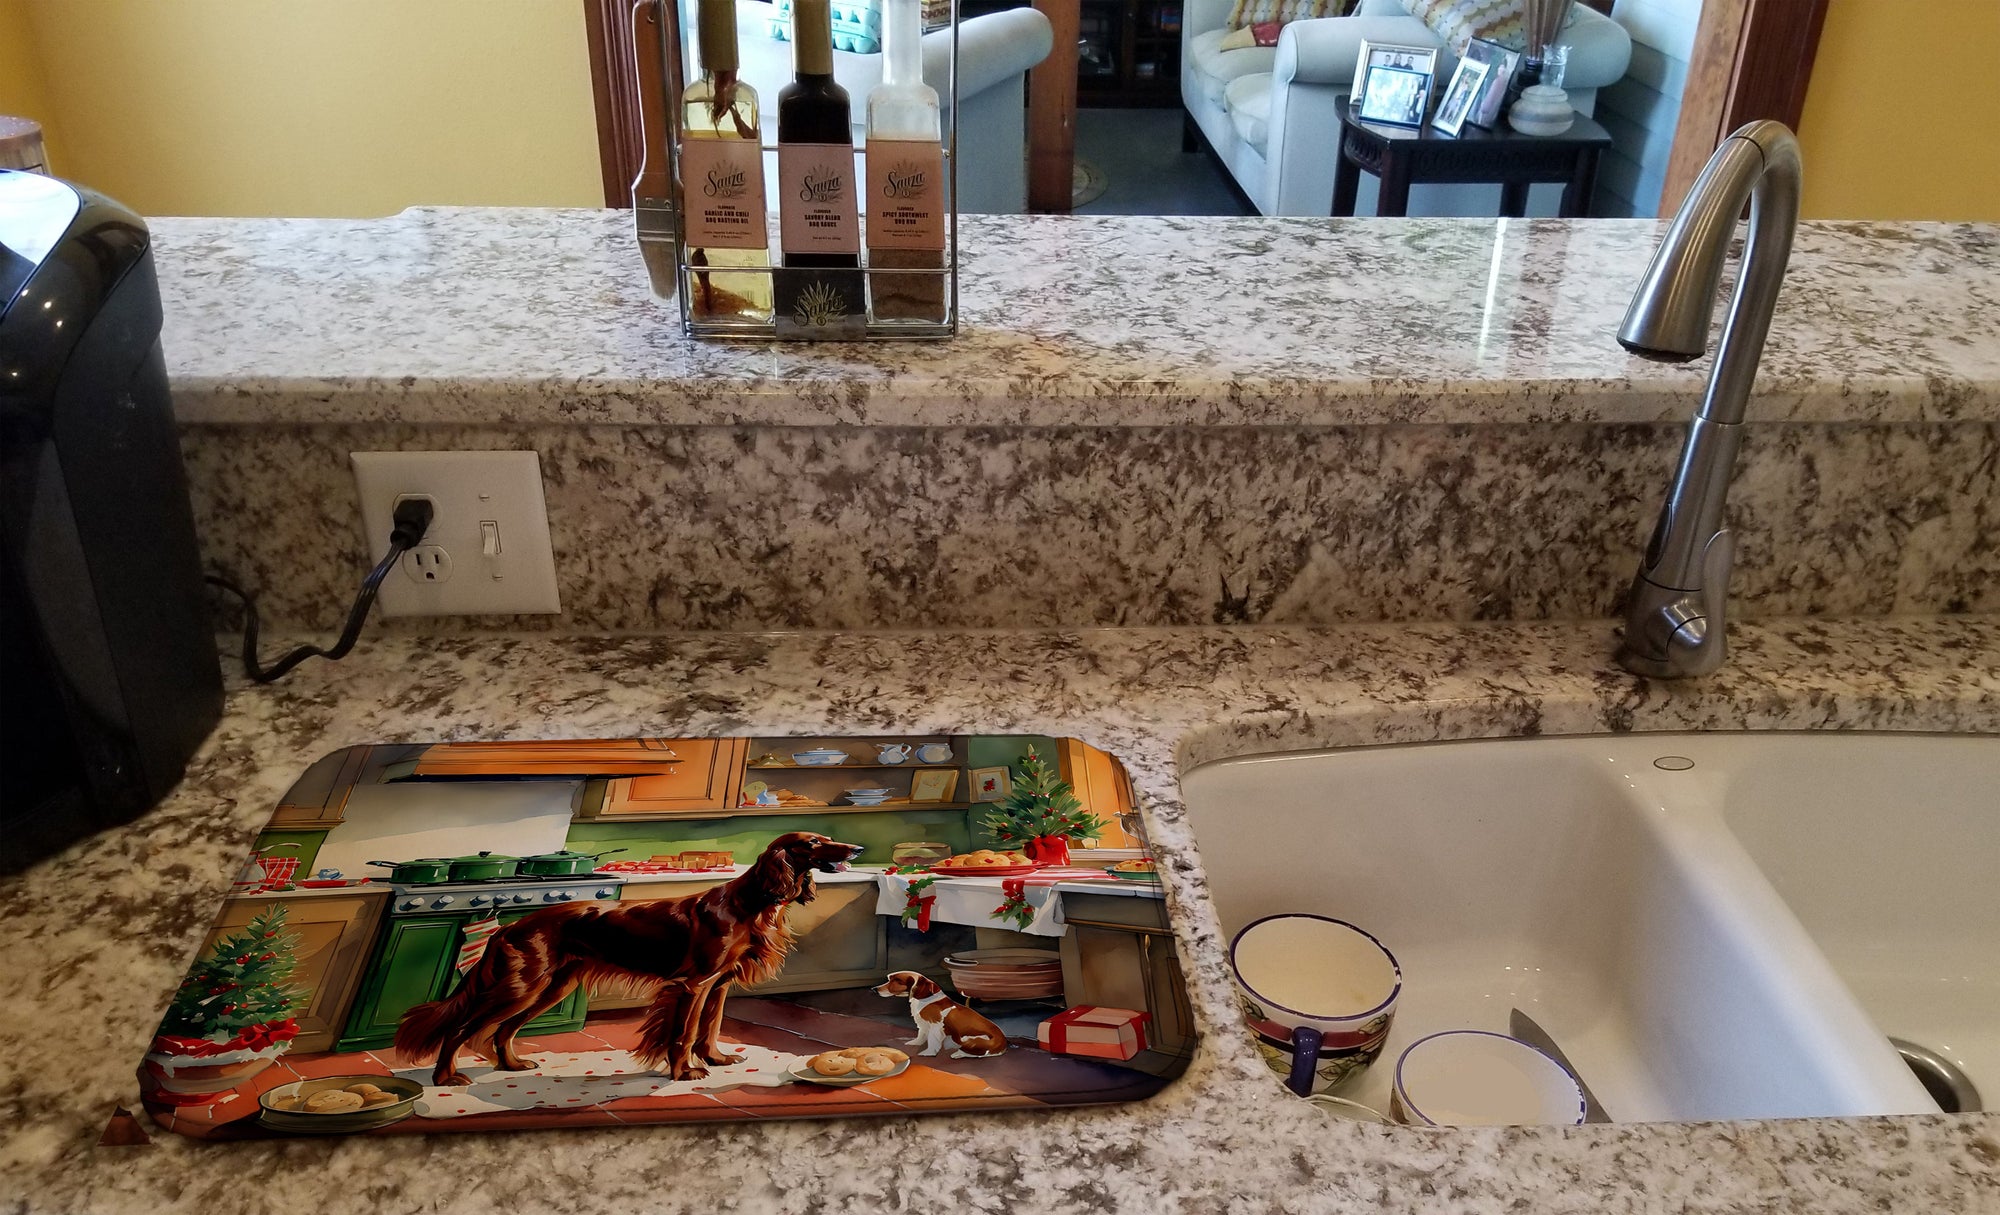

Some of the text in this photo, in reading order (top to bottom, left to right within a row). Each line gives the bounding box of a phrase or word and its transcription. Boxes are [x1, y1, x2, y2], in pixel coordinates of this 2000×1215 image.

[703, 169, 745, 197] Sauza
[800, 175, 842, 202] Sauza
[883, 171, 925, 198] Sauza
